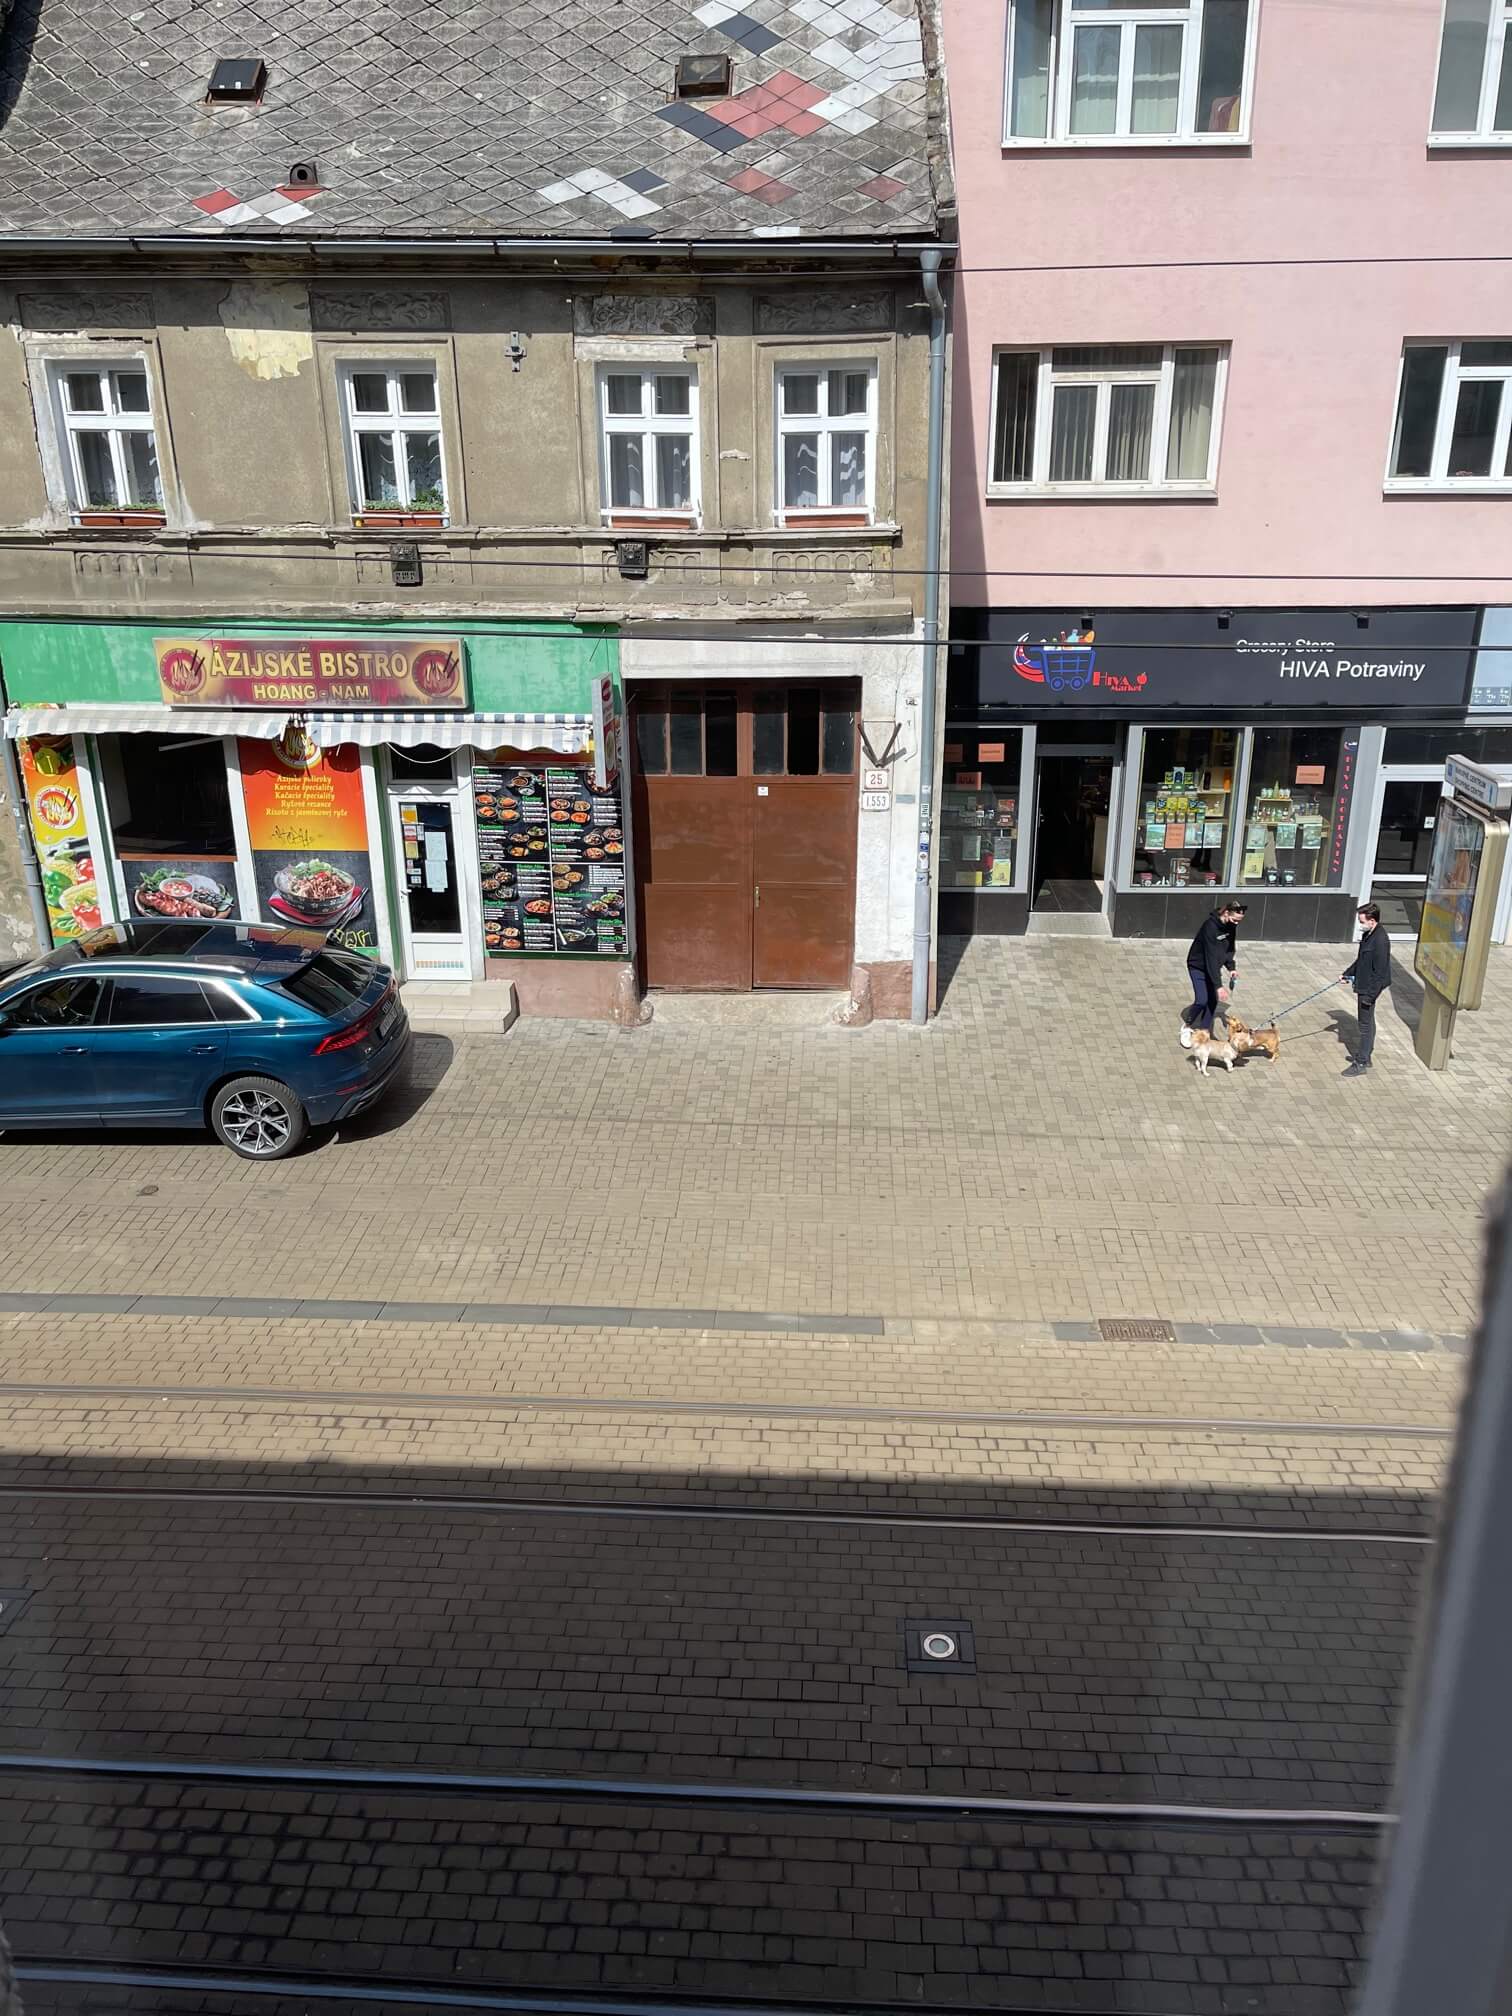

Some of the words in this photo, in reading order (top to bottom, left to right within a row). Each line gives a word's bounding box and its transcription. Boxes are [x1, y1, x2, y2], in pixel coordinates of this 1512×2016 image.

[1296, 638, 1336, 653] Store
[210, 646, 313, 677] ÁZIJSKÉ
[320, 650, 409, 679] BISTRO
[1280, 660, 1330, 678] HIVA
[1335, 659, 1425, 681] Potraviny
[253, 684, 316, 700] HOANG
[332, 684, 370, 701] NAM
[870, 774, 883, 785] 25
